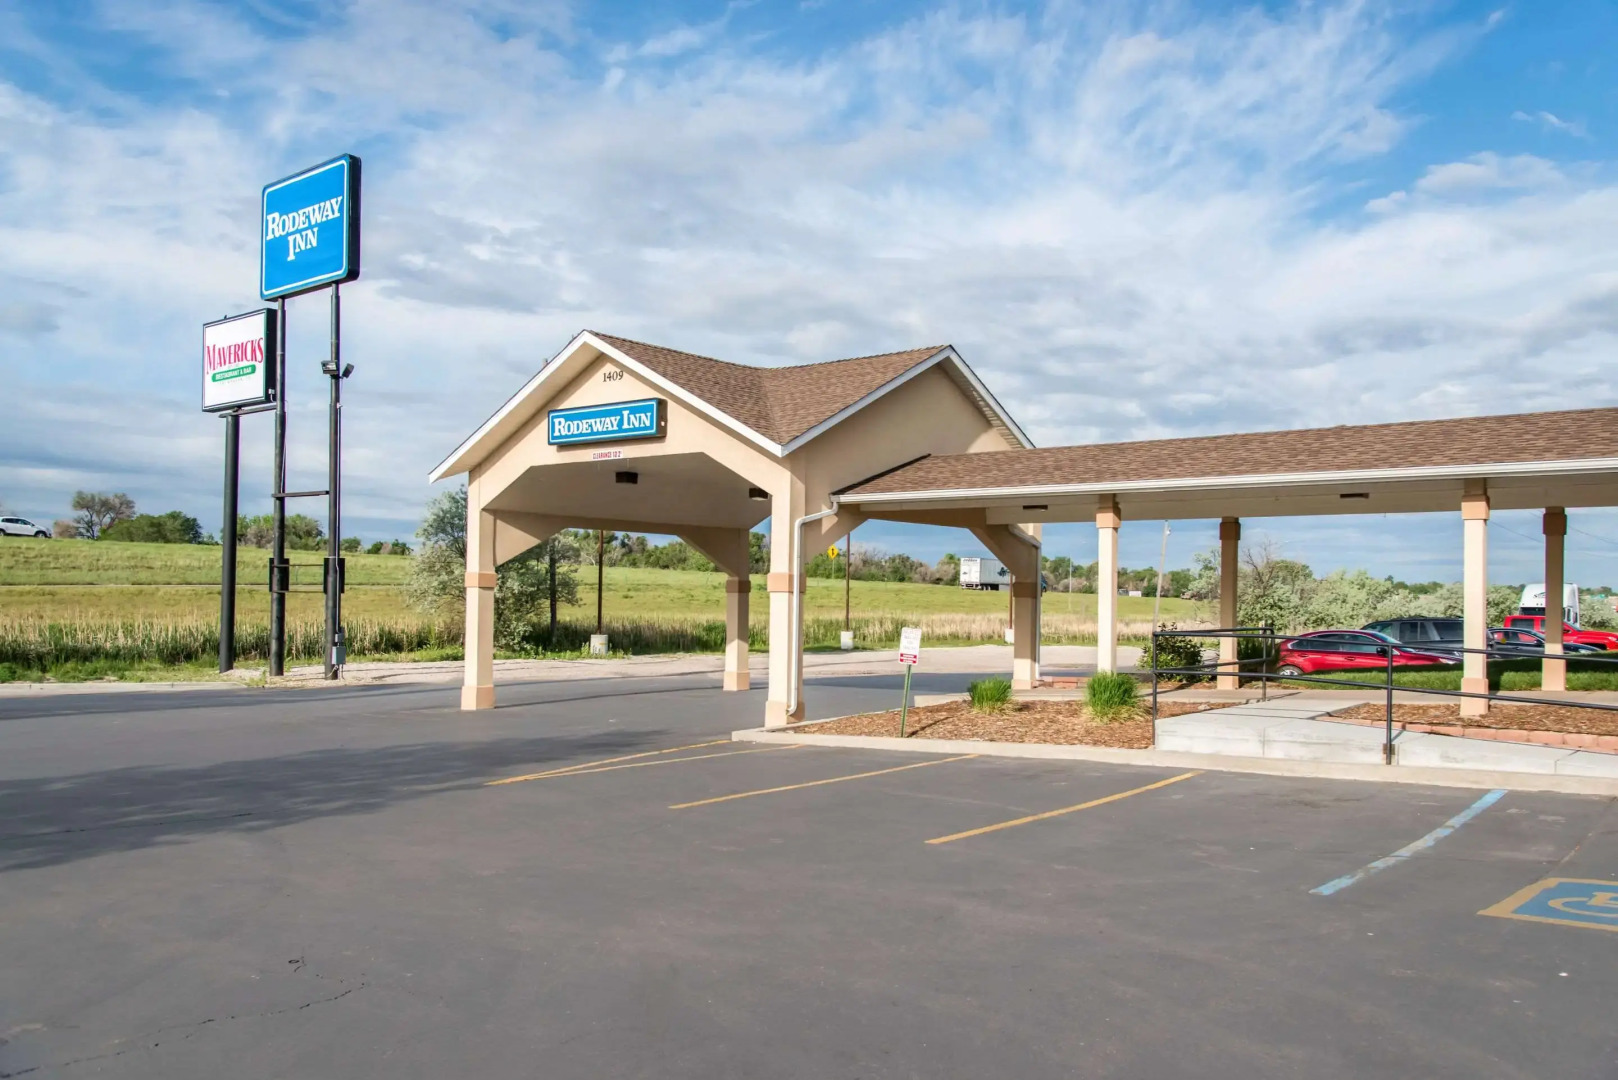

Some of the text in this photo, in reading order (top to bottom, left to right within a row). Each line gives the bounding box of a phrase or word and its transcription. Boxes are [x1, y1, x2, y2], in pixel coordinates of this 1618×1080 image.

[266, 195, 343, 240] RODEWAY
[287, 227, 318, 261] INN
[206, 337, 264, 375] MAVERICKS
[602, 370, 624, 382] 1409
[553, 410, 651, 436] RODEWAY INN
